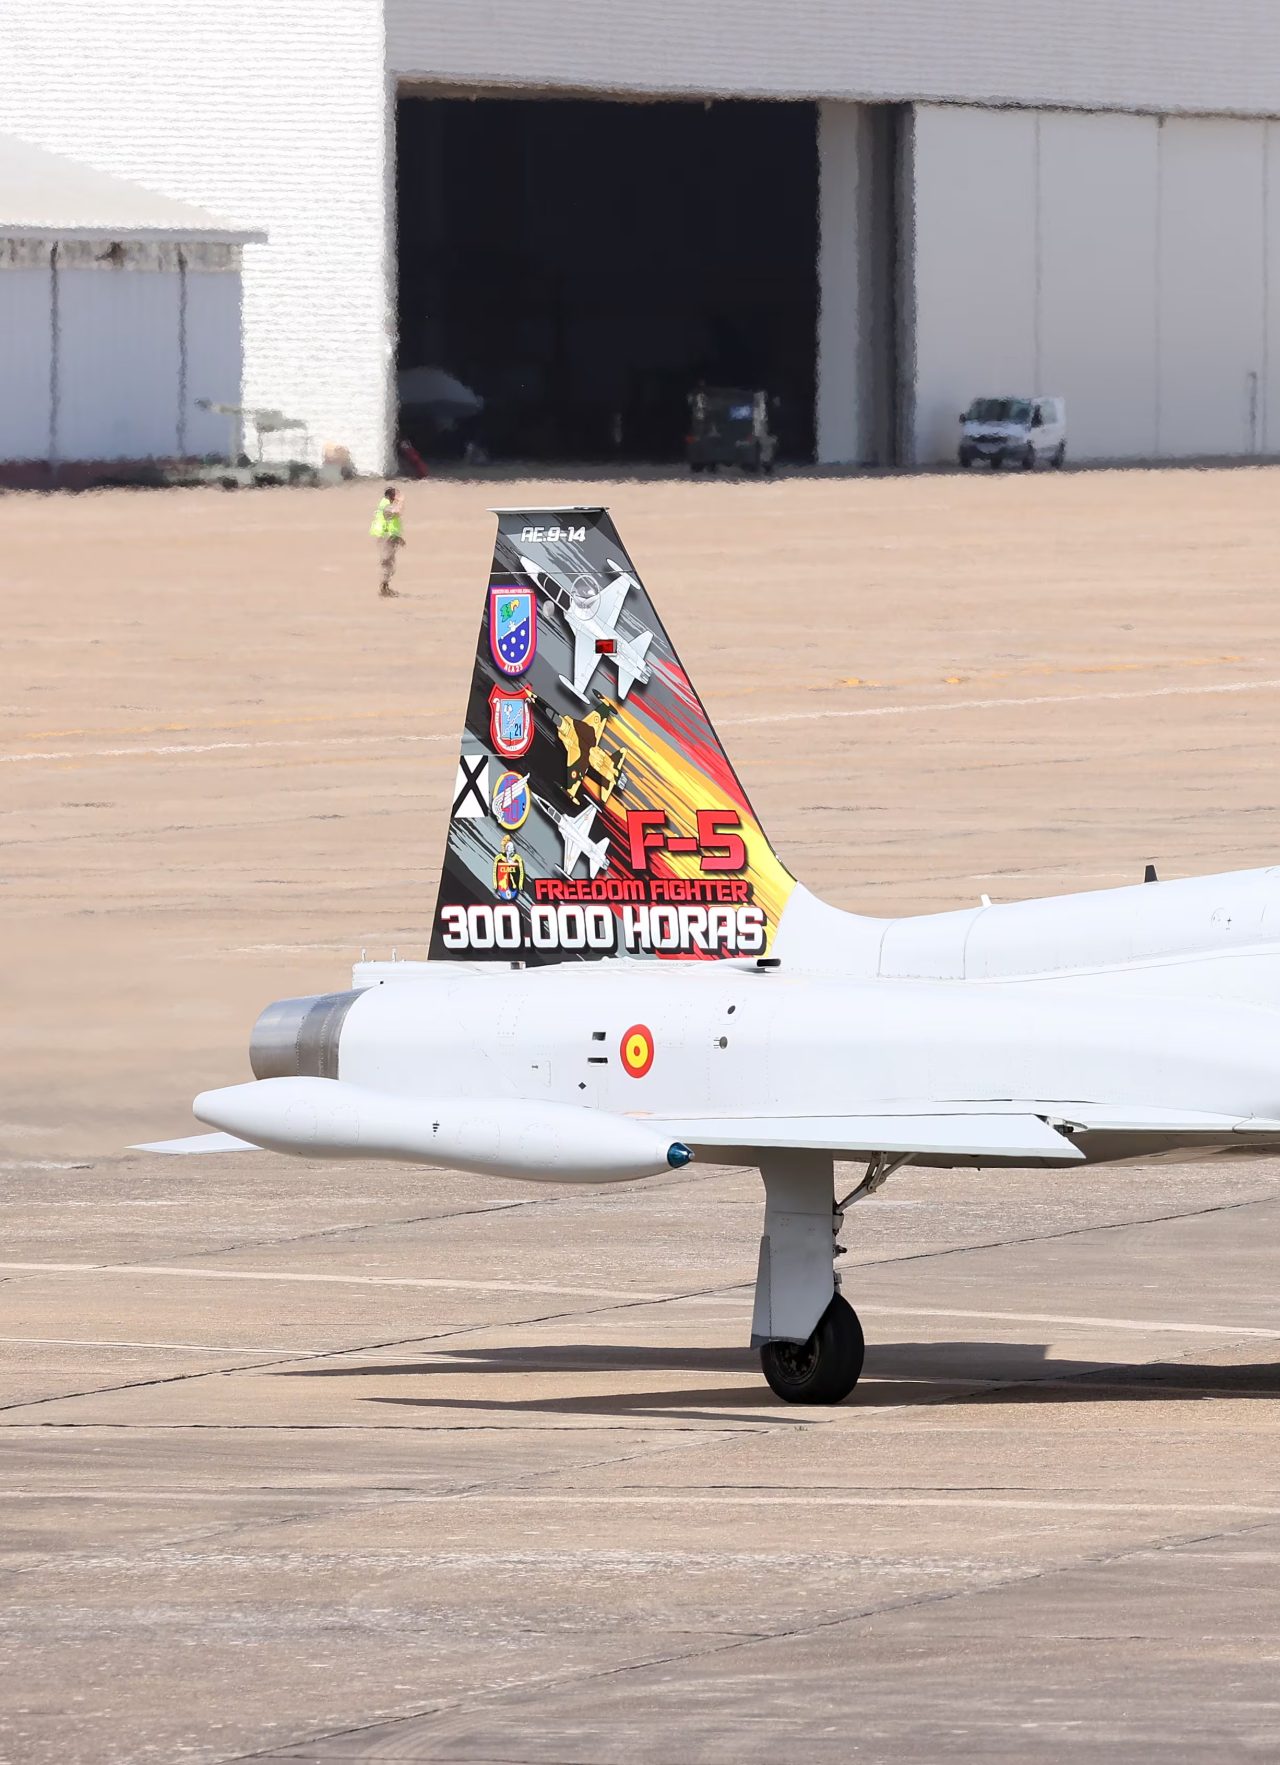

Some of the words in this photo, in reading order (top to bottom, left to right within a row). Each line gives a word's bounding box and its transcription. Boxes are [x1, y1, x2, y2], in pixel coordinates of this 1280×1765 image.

[520, 526, 586, 542] AE.9-14
[514, 723, 522, 737] 21
[625, 810, 747, 870] F-5
[534, 879, 646, 901] FREEDOM
[650, 879, 749, 902] FIGHTER
[441, 904, 615, 949] 300.000
[623, 904, 766, 949] HORAS
